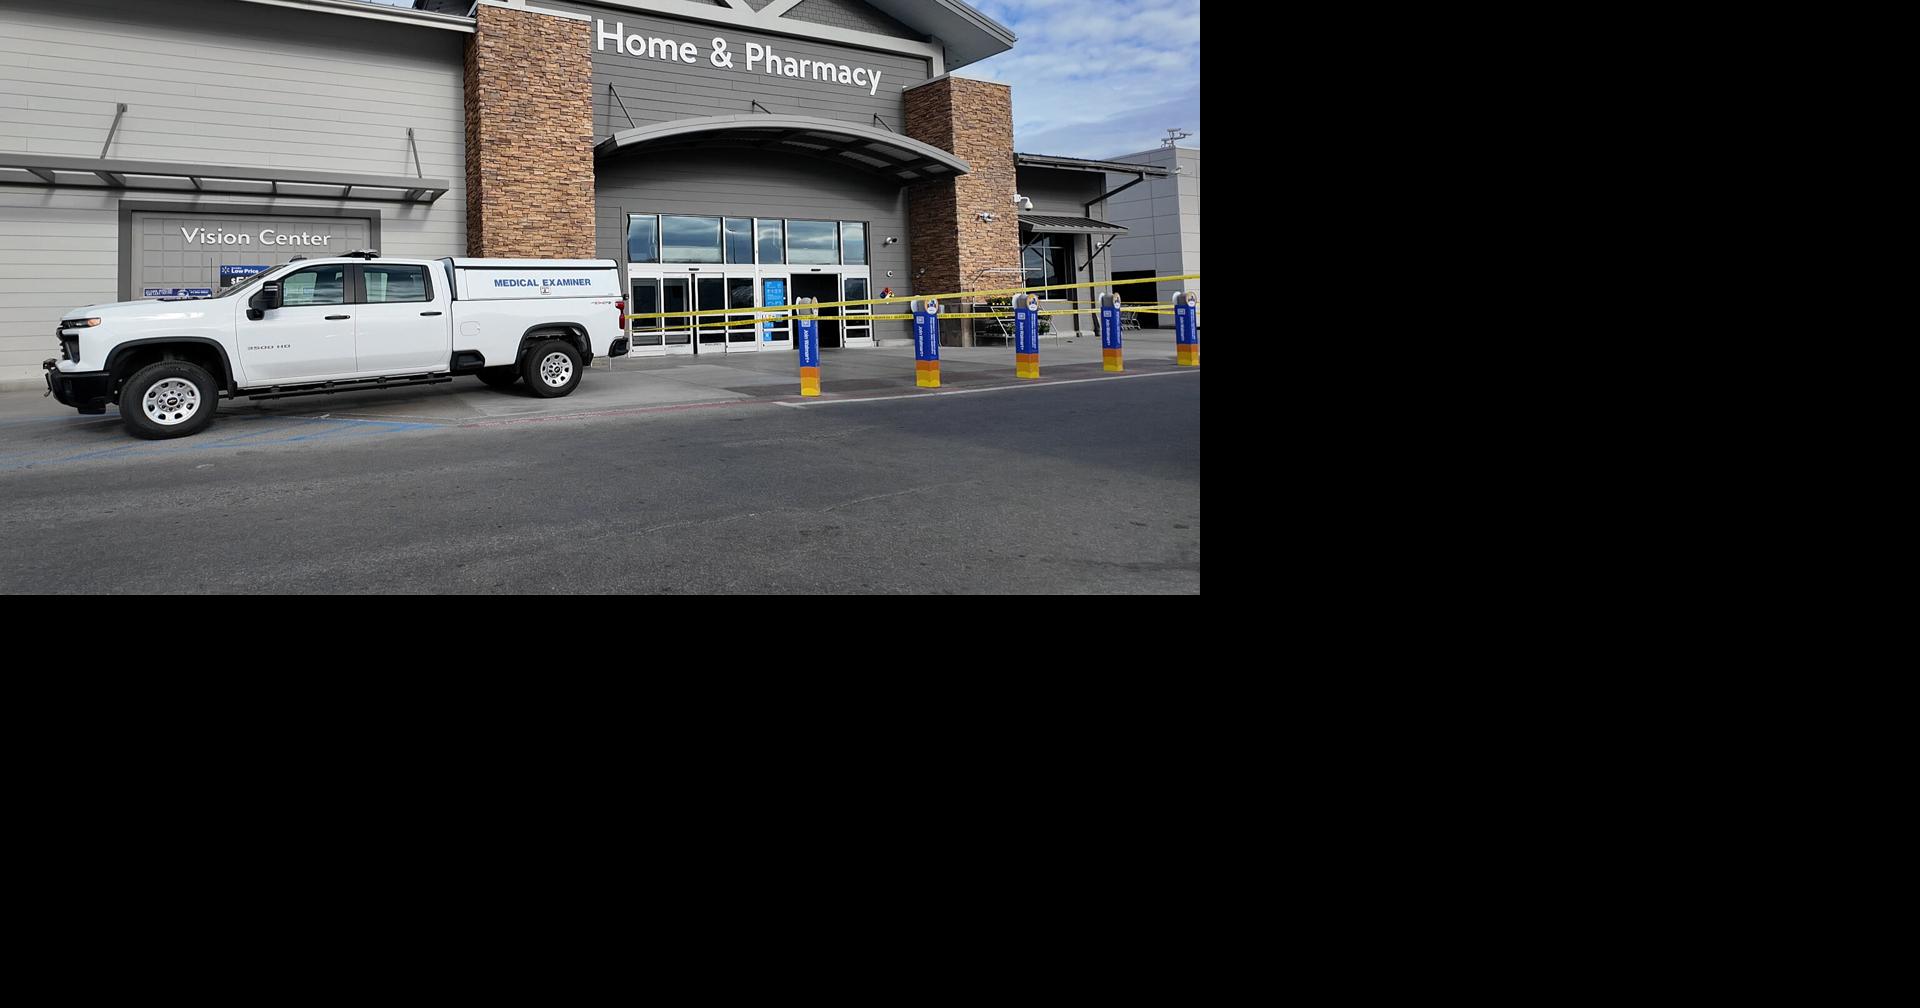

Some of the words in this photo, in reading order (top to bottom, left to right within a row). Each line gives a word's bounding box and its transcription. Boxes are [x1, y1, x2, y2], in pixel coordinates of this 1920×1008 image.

[597, 19, 698, 64] Home
[710, 37, 733, 69] &
[745, 42, 882, 96] Pharmacy
[180, 227, 250, 245] Vision
[259, 229, 332, 246] Center
[494, 279, 539, 287] MEDICAL
[542, 278, 592, 287] EXAMINER
